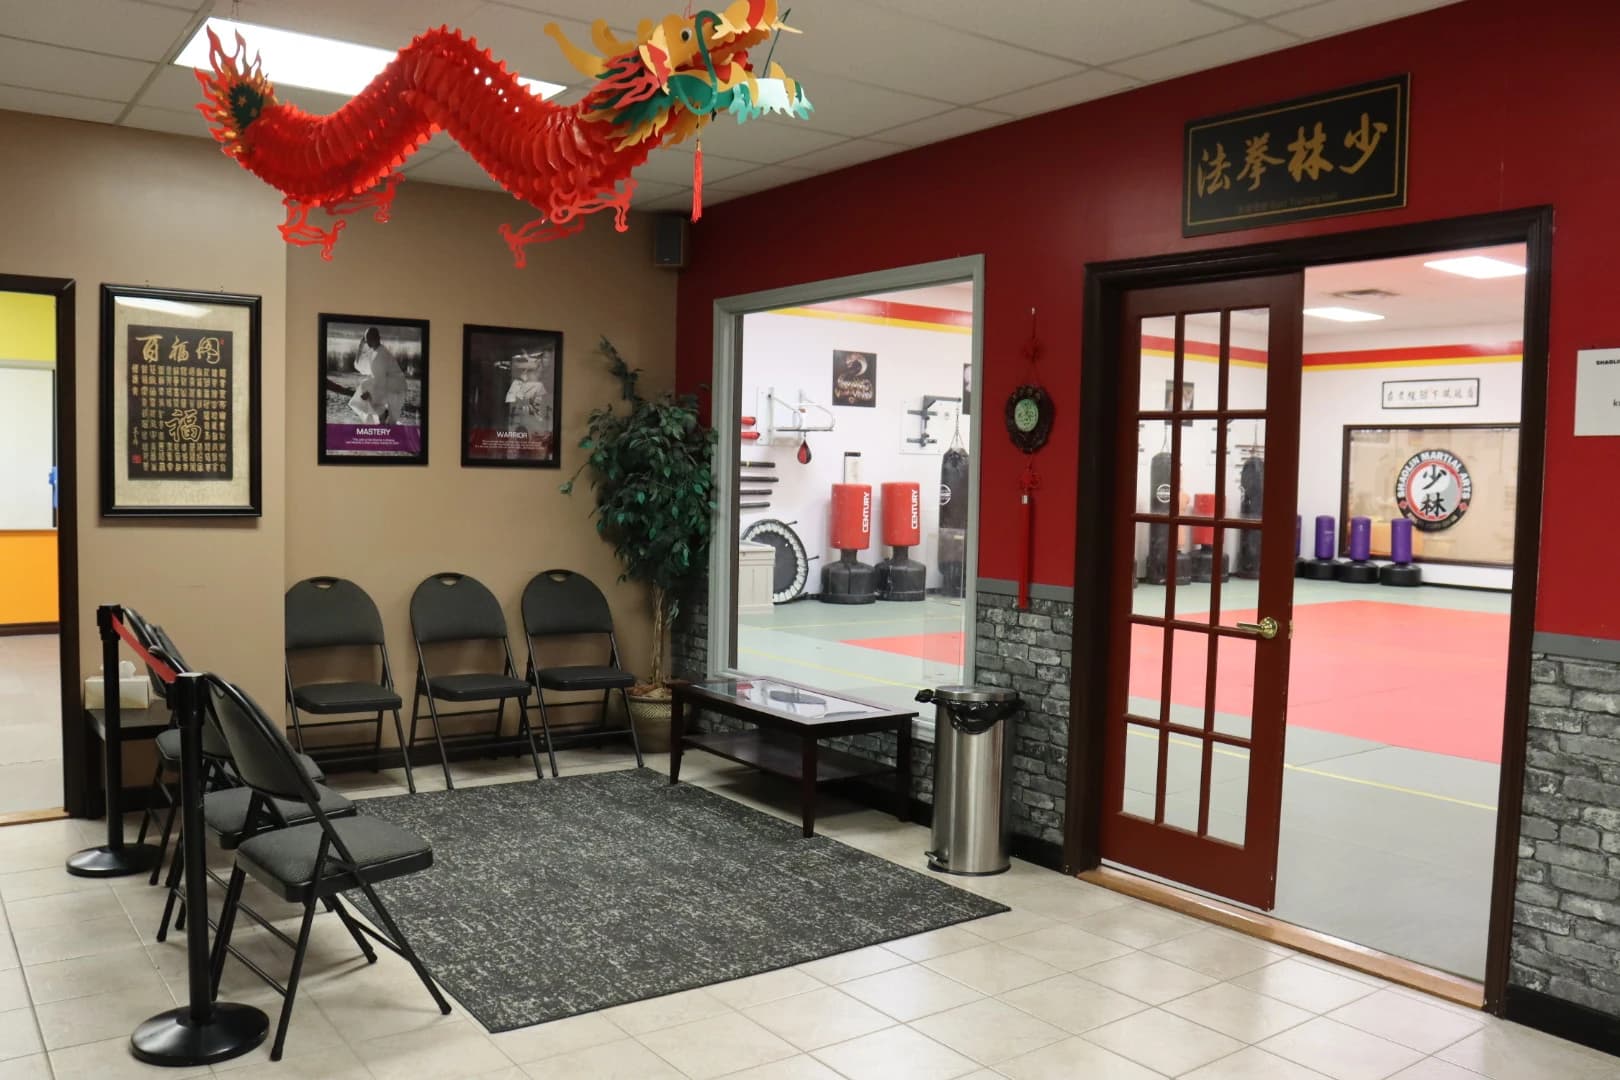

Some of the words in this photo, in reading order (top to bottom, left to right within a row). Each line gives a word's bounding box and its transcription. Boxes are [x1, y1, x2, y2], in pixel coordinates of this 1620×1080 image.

[356, 428, 391, 436] MASTERY
[496, 431, 528, 439] WARRIOR
[1397, 456, 1421, 498] SHAOLIN
[1420, 451, 1462, 472] MARTIAL
[1459, 472, 1471, 499] ARTS
[862, 491, 871, 533] CENTURY
[911, 489, 919, 530] CENTURY
